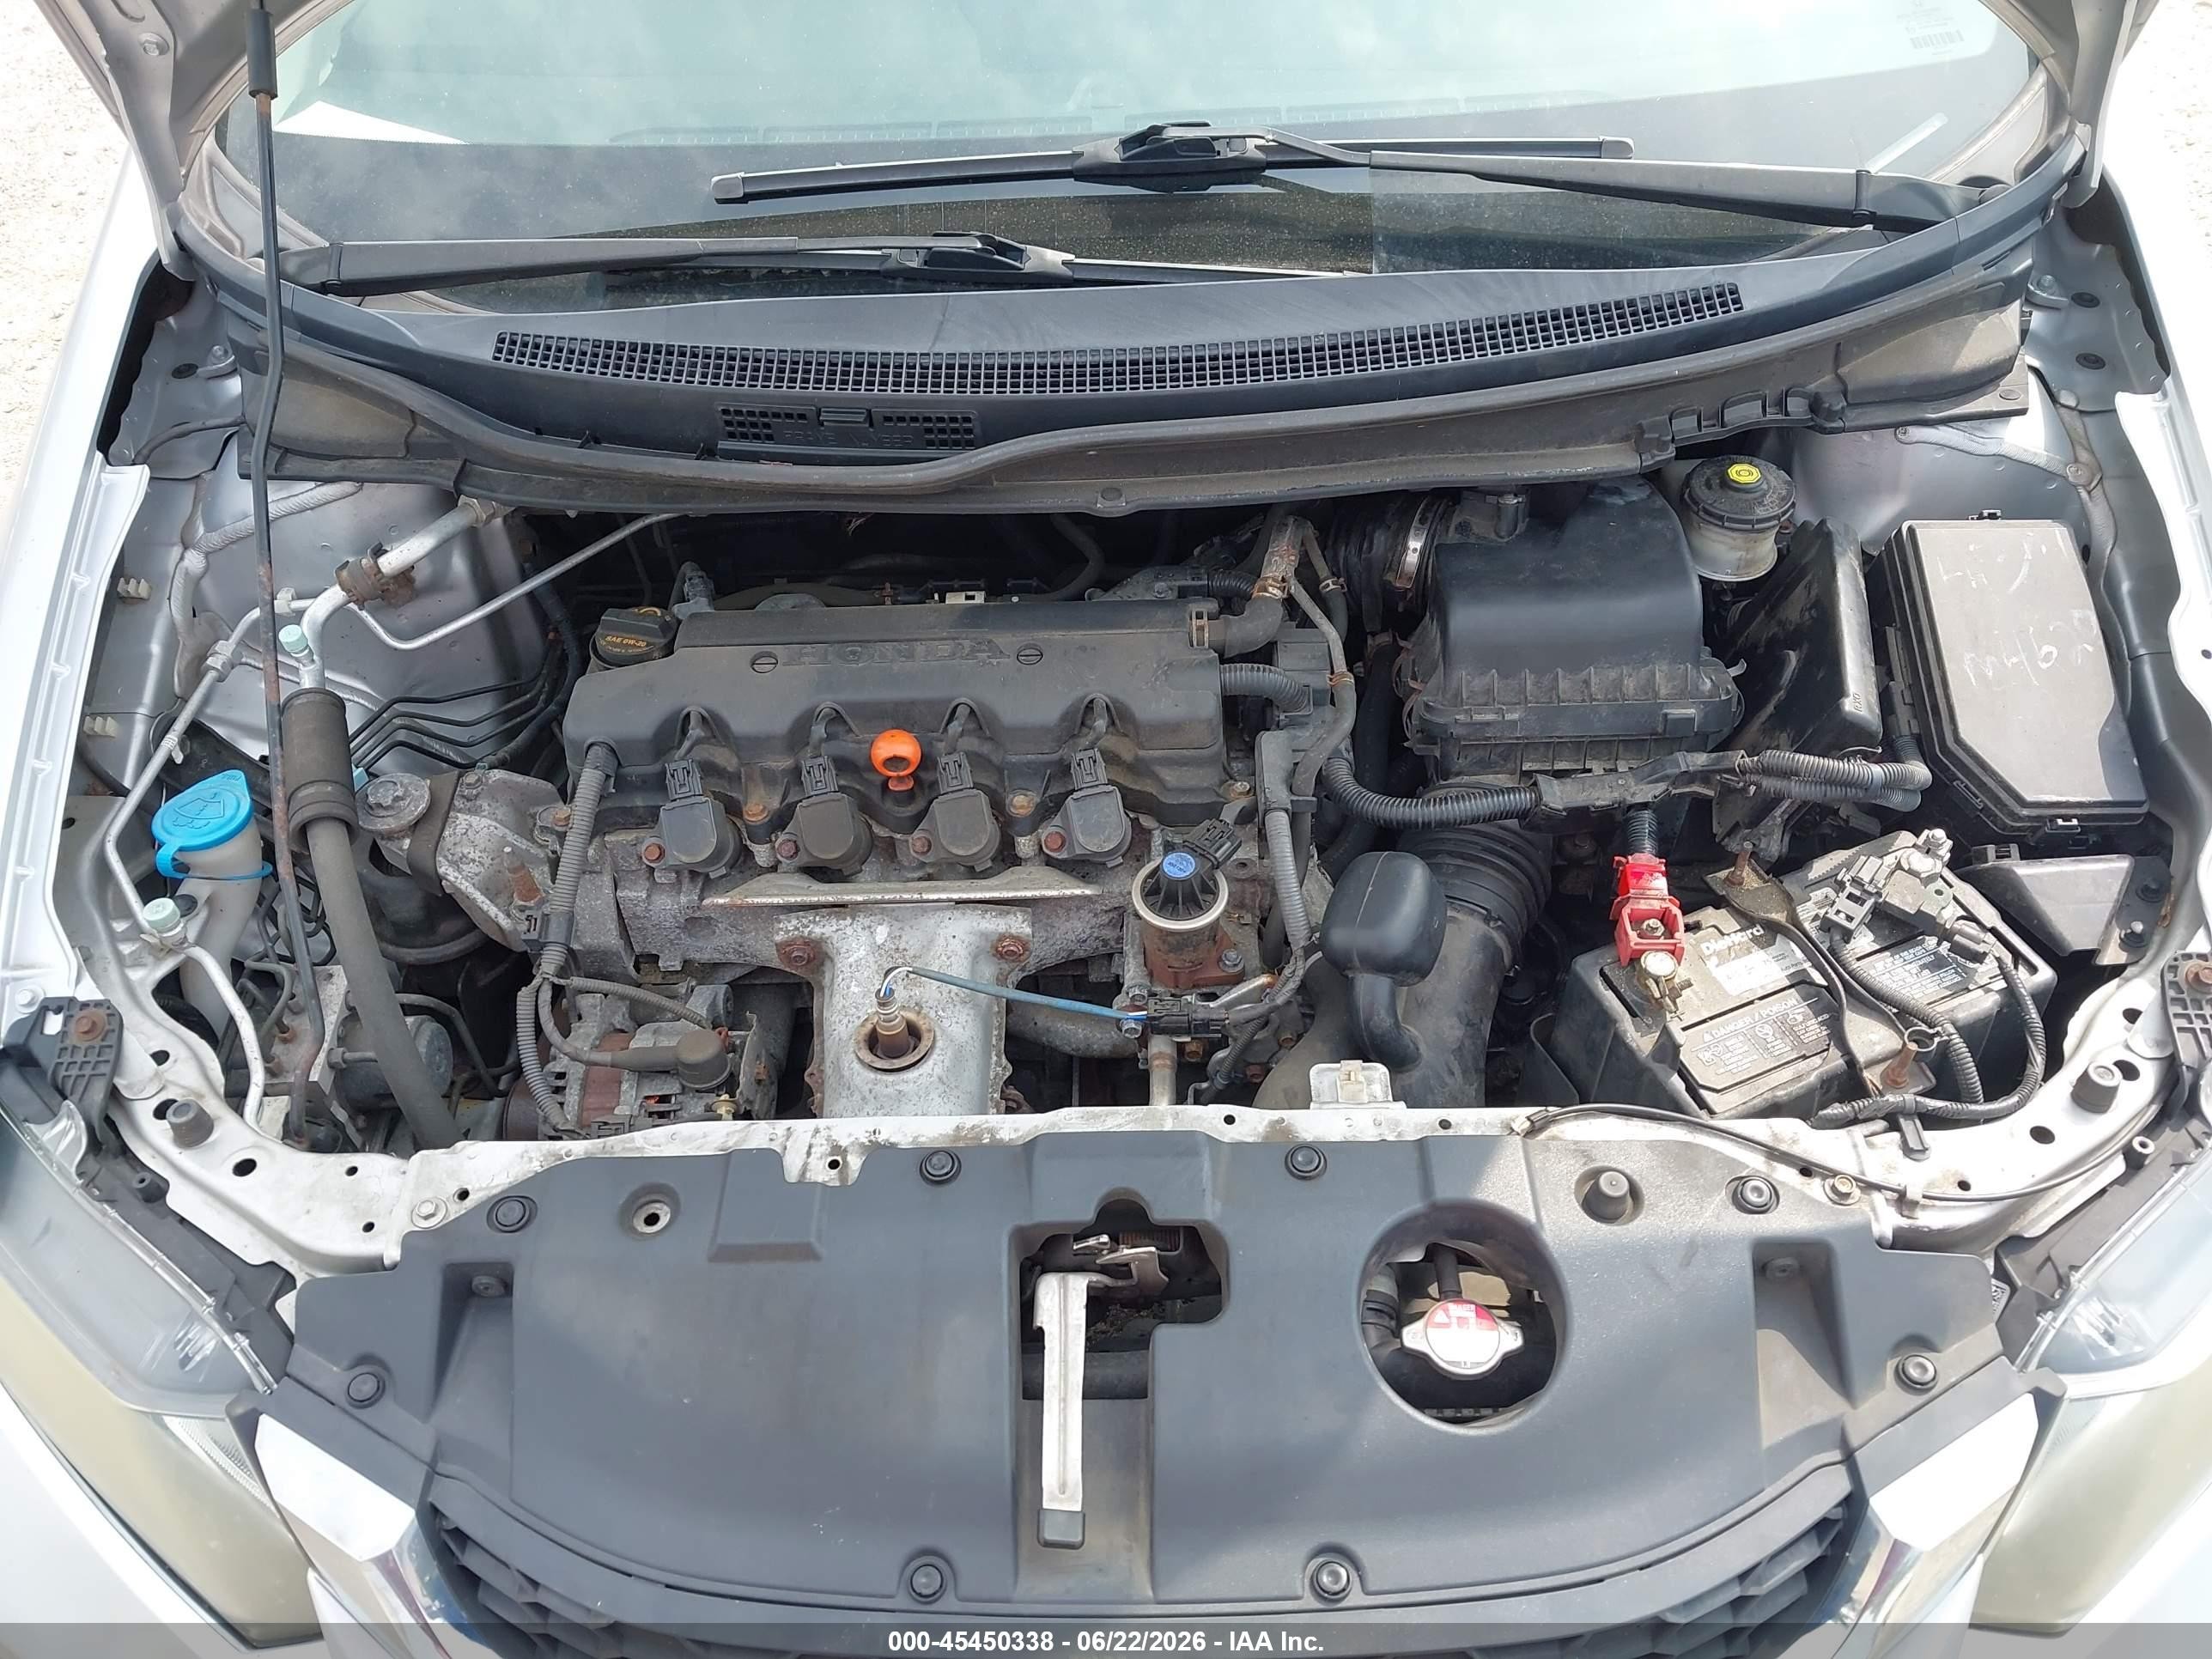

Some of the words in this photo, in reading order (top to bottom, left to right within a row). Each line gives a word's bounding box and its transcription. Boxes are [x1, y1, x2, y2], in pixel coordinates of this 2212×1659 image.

[623, 638, 647, 647] 0W-20
[781, 640, 1012, 666] HONDA
[1699, 923, 1765, 956] DieHard
[1711, 1015, 1754, 1038] DANGER
[1759, 997, 1800, 1018] POISON
